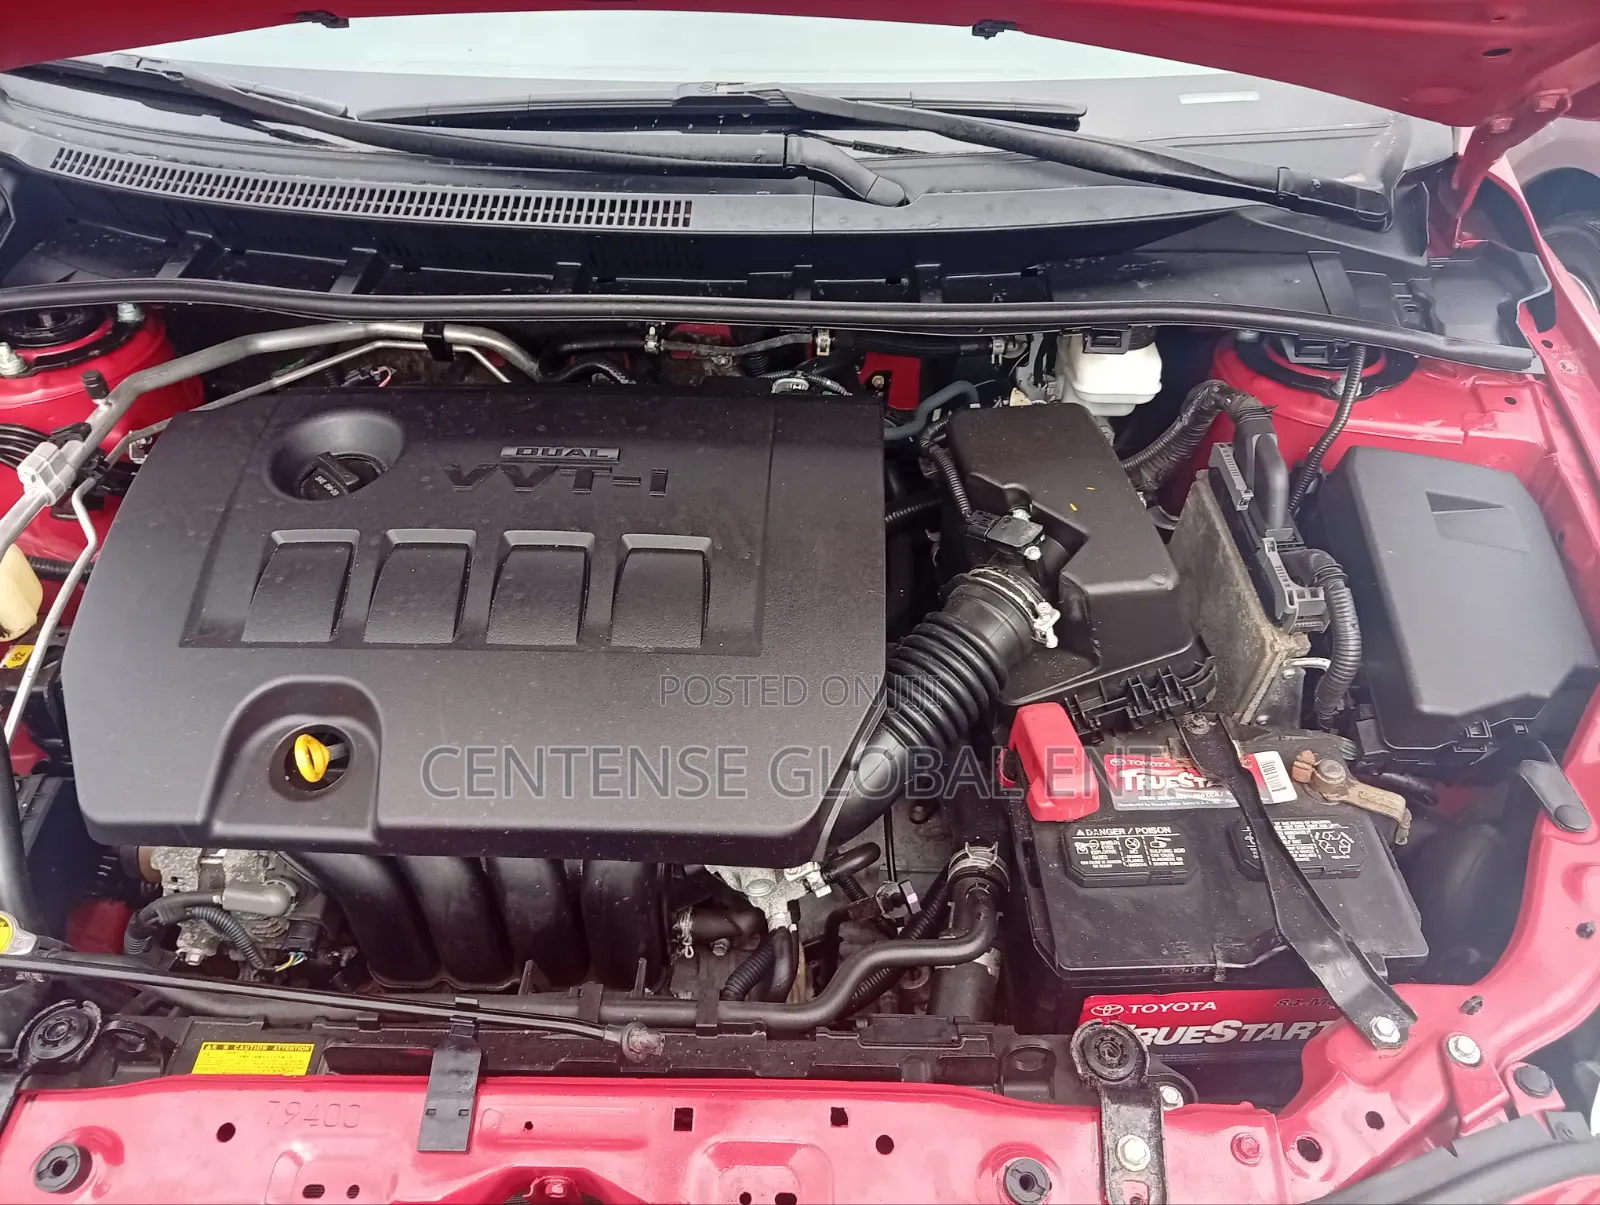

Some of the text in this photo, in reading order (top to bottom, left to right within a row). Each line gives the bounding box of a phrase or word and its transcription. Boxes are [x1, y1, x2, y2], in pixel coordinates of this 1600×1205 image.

[515, 447, 612, 458] DUAL
[1127, 758, 1172, 768] TOYOTA
[1085, 827, 1126, 836] DANGER
[1135, 826, 1172, 834] POISON
[1128, 1001, 1217, 1014] TOYOTA
[1127, 1019, 1339, 1046] RUESTART
